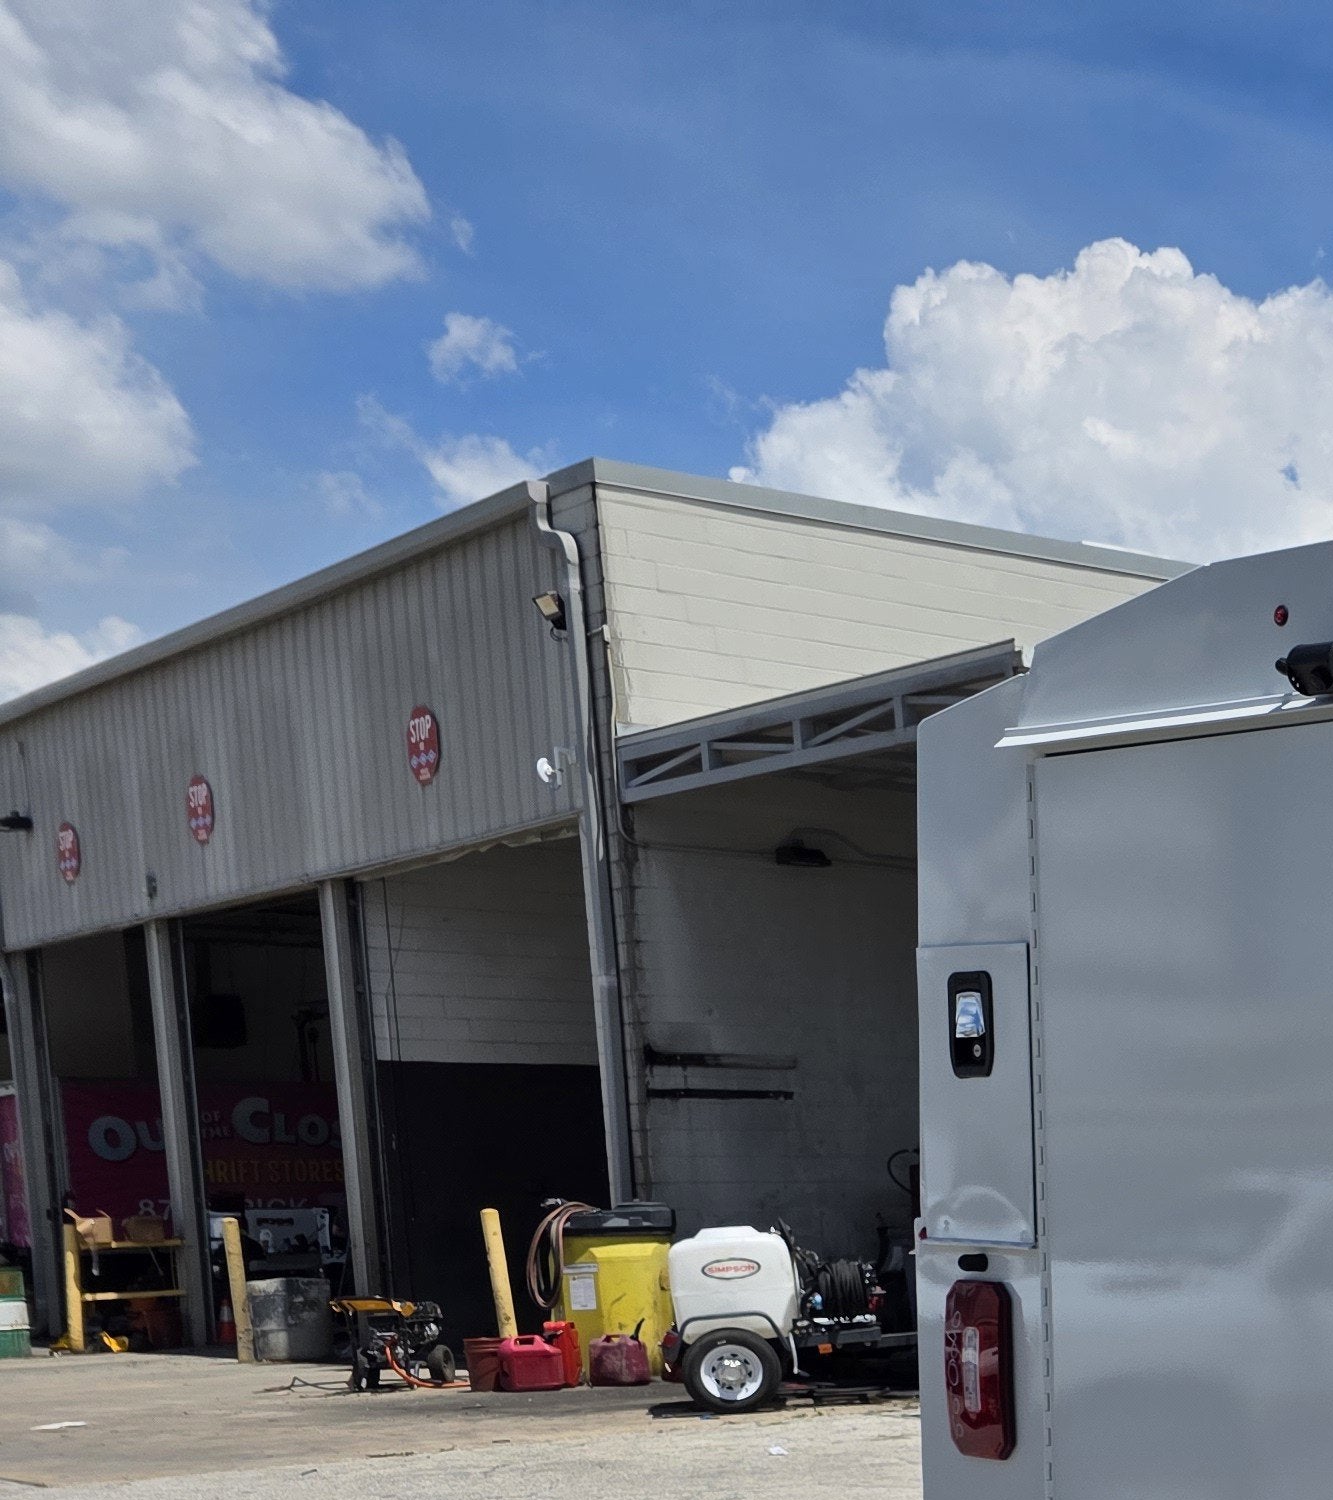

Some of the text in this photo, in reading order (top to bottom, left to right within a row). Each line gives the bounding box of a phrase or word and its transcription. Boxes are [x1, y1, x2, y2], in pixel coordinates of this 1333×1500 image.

[410, 714, 431, 744] STOP
[188, 782, 208, 808] STOP
[87, 1115, 165, 1162] OU
[205, 1159, 264, 1184] HRIFT
[706, 1264, 755, 1275] SIMPSON
